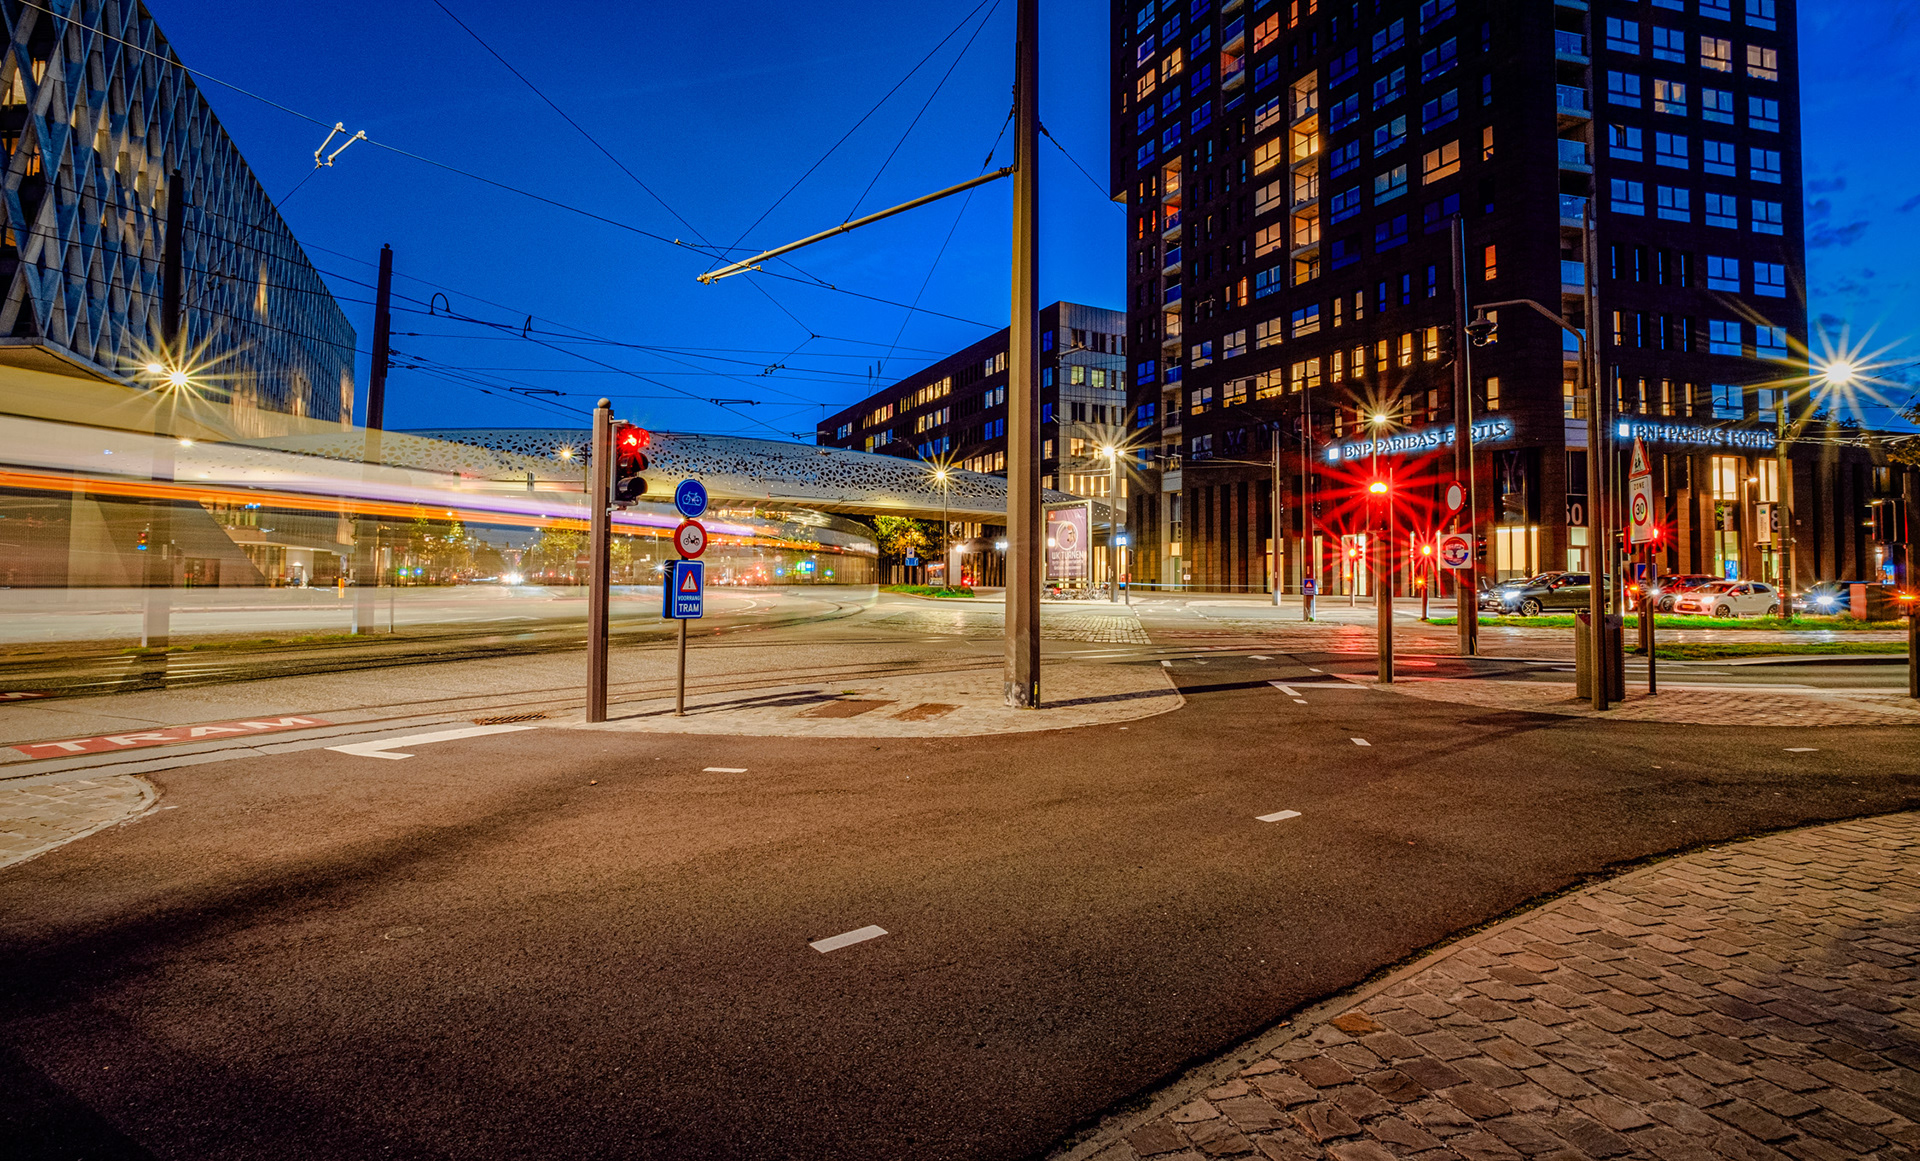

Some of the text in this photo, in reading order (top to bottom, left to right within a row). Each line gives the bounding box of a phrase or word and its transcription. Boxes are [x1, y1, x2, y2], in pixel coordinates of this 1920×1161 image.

[1344, 422, 1506, 458] BNP PARIBAS FRTIS
[1636, 424, 1776, 449] BNP PARIBAS FORTIS
[1635, 503, 1644, 515] 30
[679, 603, 700, 612] TRAM
[32, 715, 315, 752] TRAM
